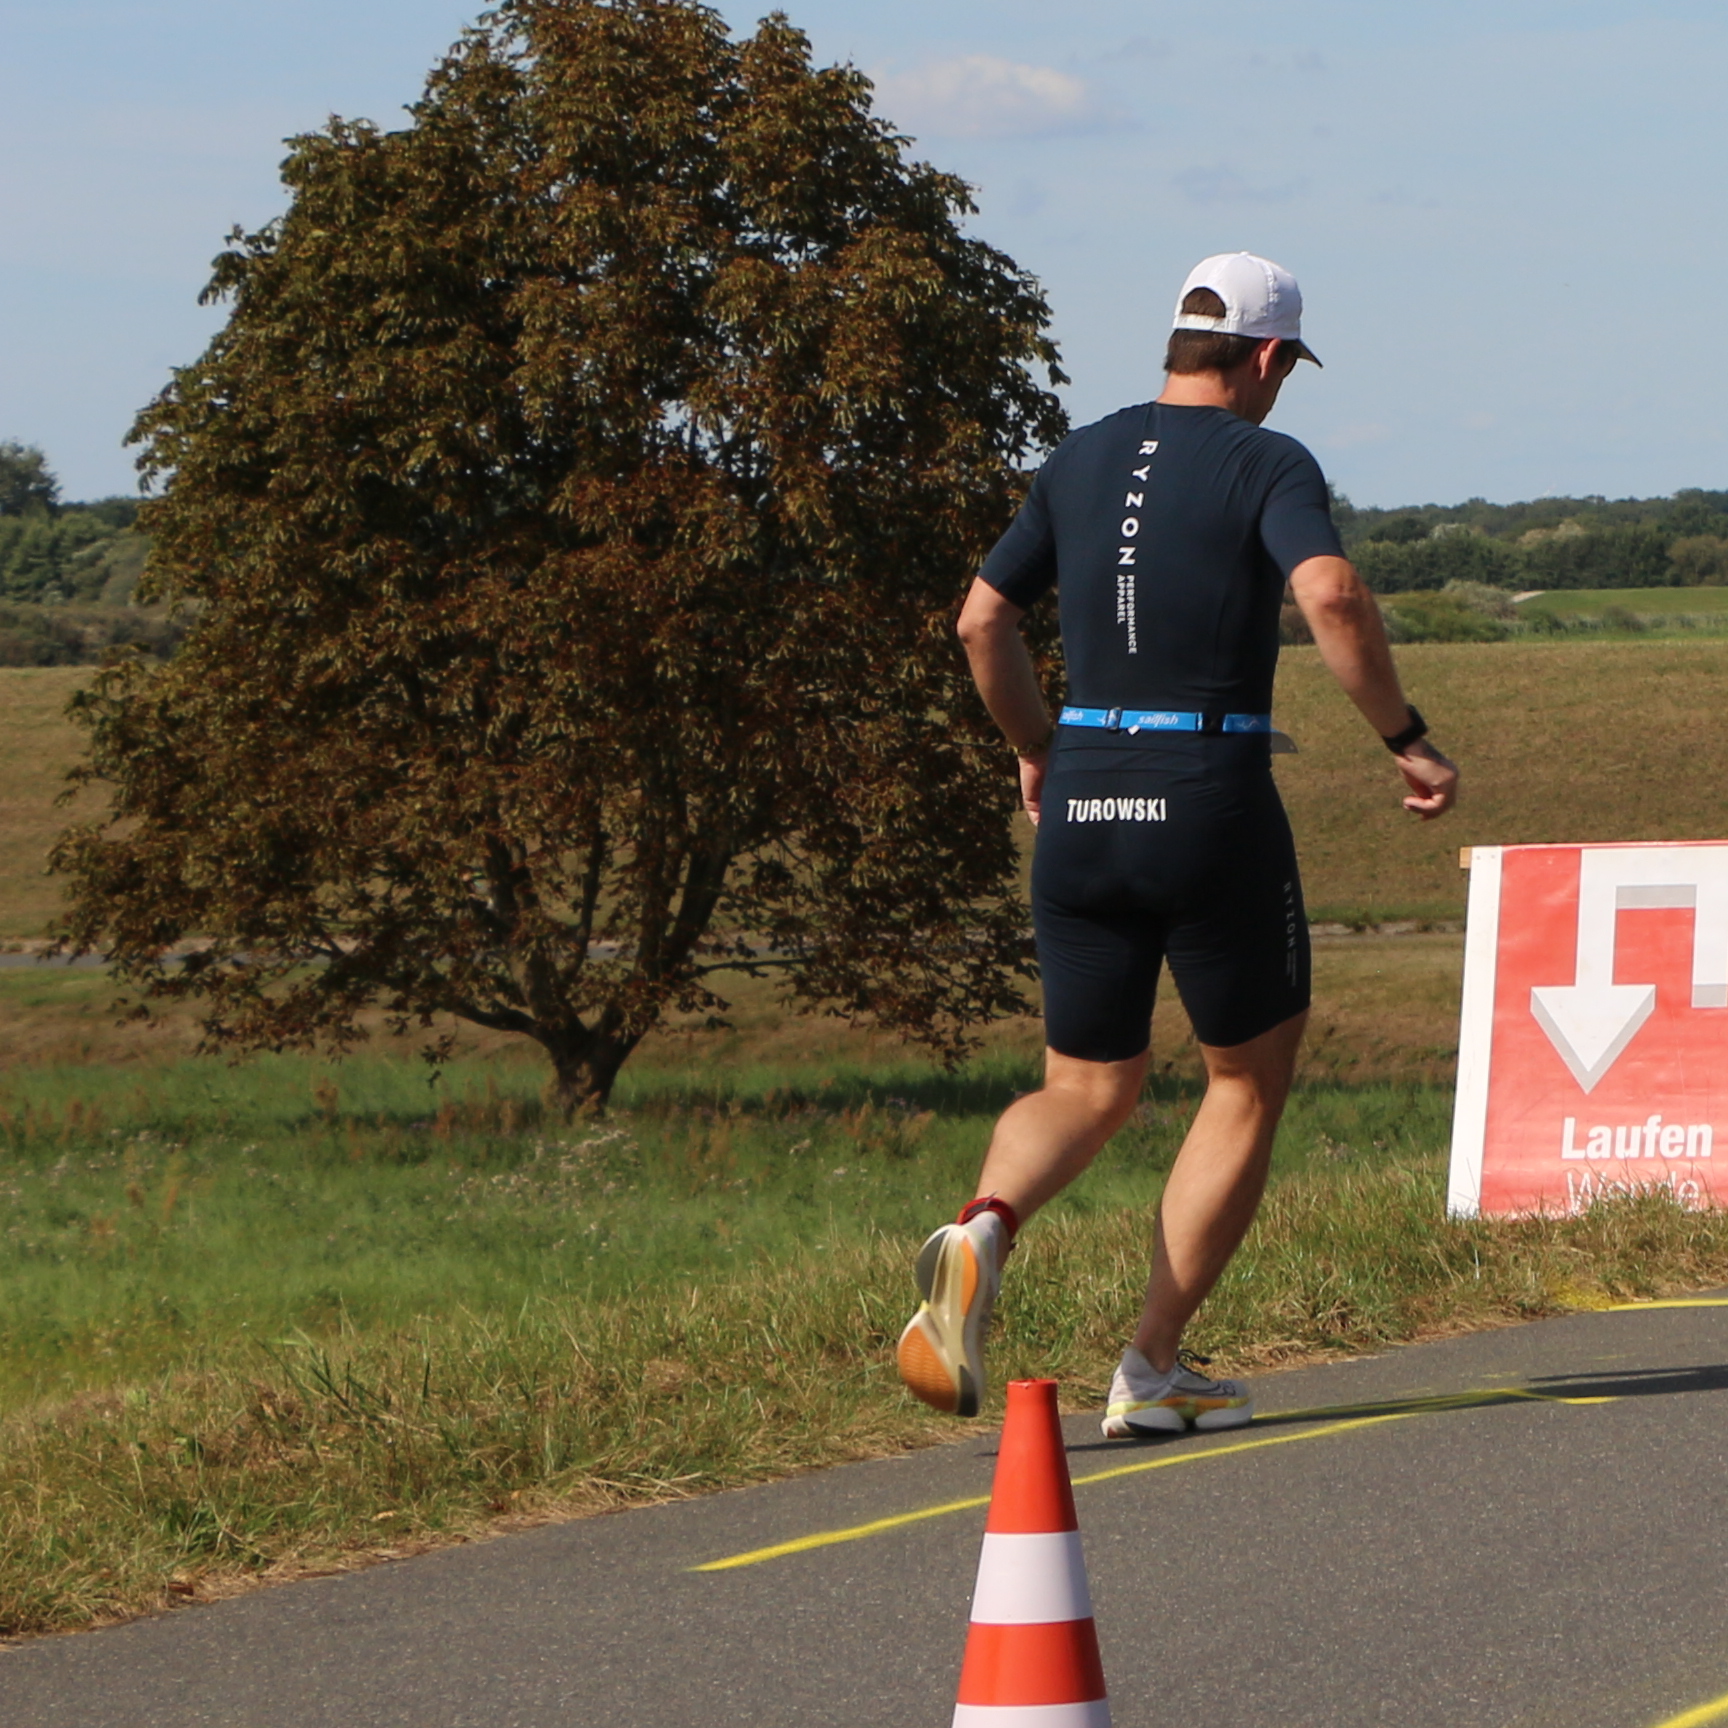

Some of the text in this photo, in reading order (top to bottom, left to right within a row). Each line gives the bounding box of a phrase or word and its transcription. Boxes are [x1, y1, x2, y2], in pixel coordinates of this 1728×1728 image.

[1117, 439, 1160, 566] RYZON
[1116, 574, 1127, 625] APPAREL
[1126, 574, 1138, 655] PERFORMANCE
[1137, 712, 1179, 729] sailfish
[1066, 797, 1167, 823] TUROWSKI
[1561, 1114, 1714, 1160] Laufen
